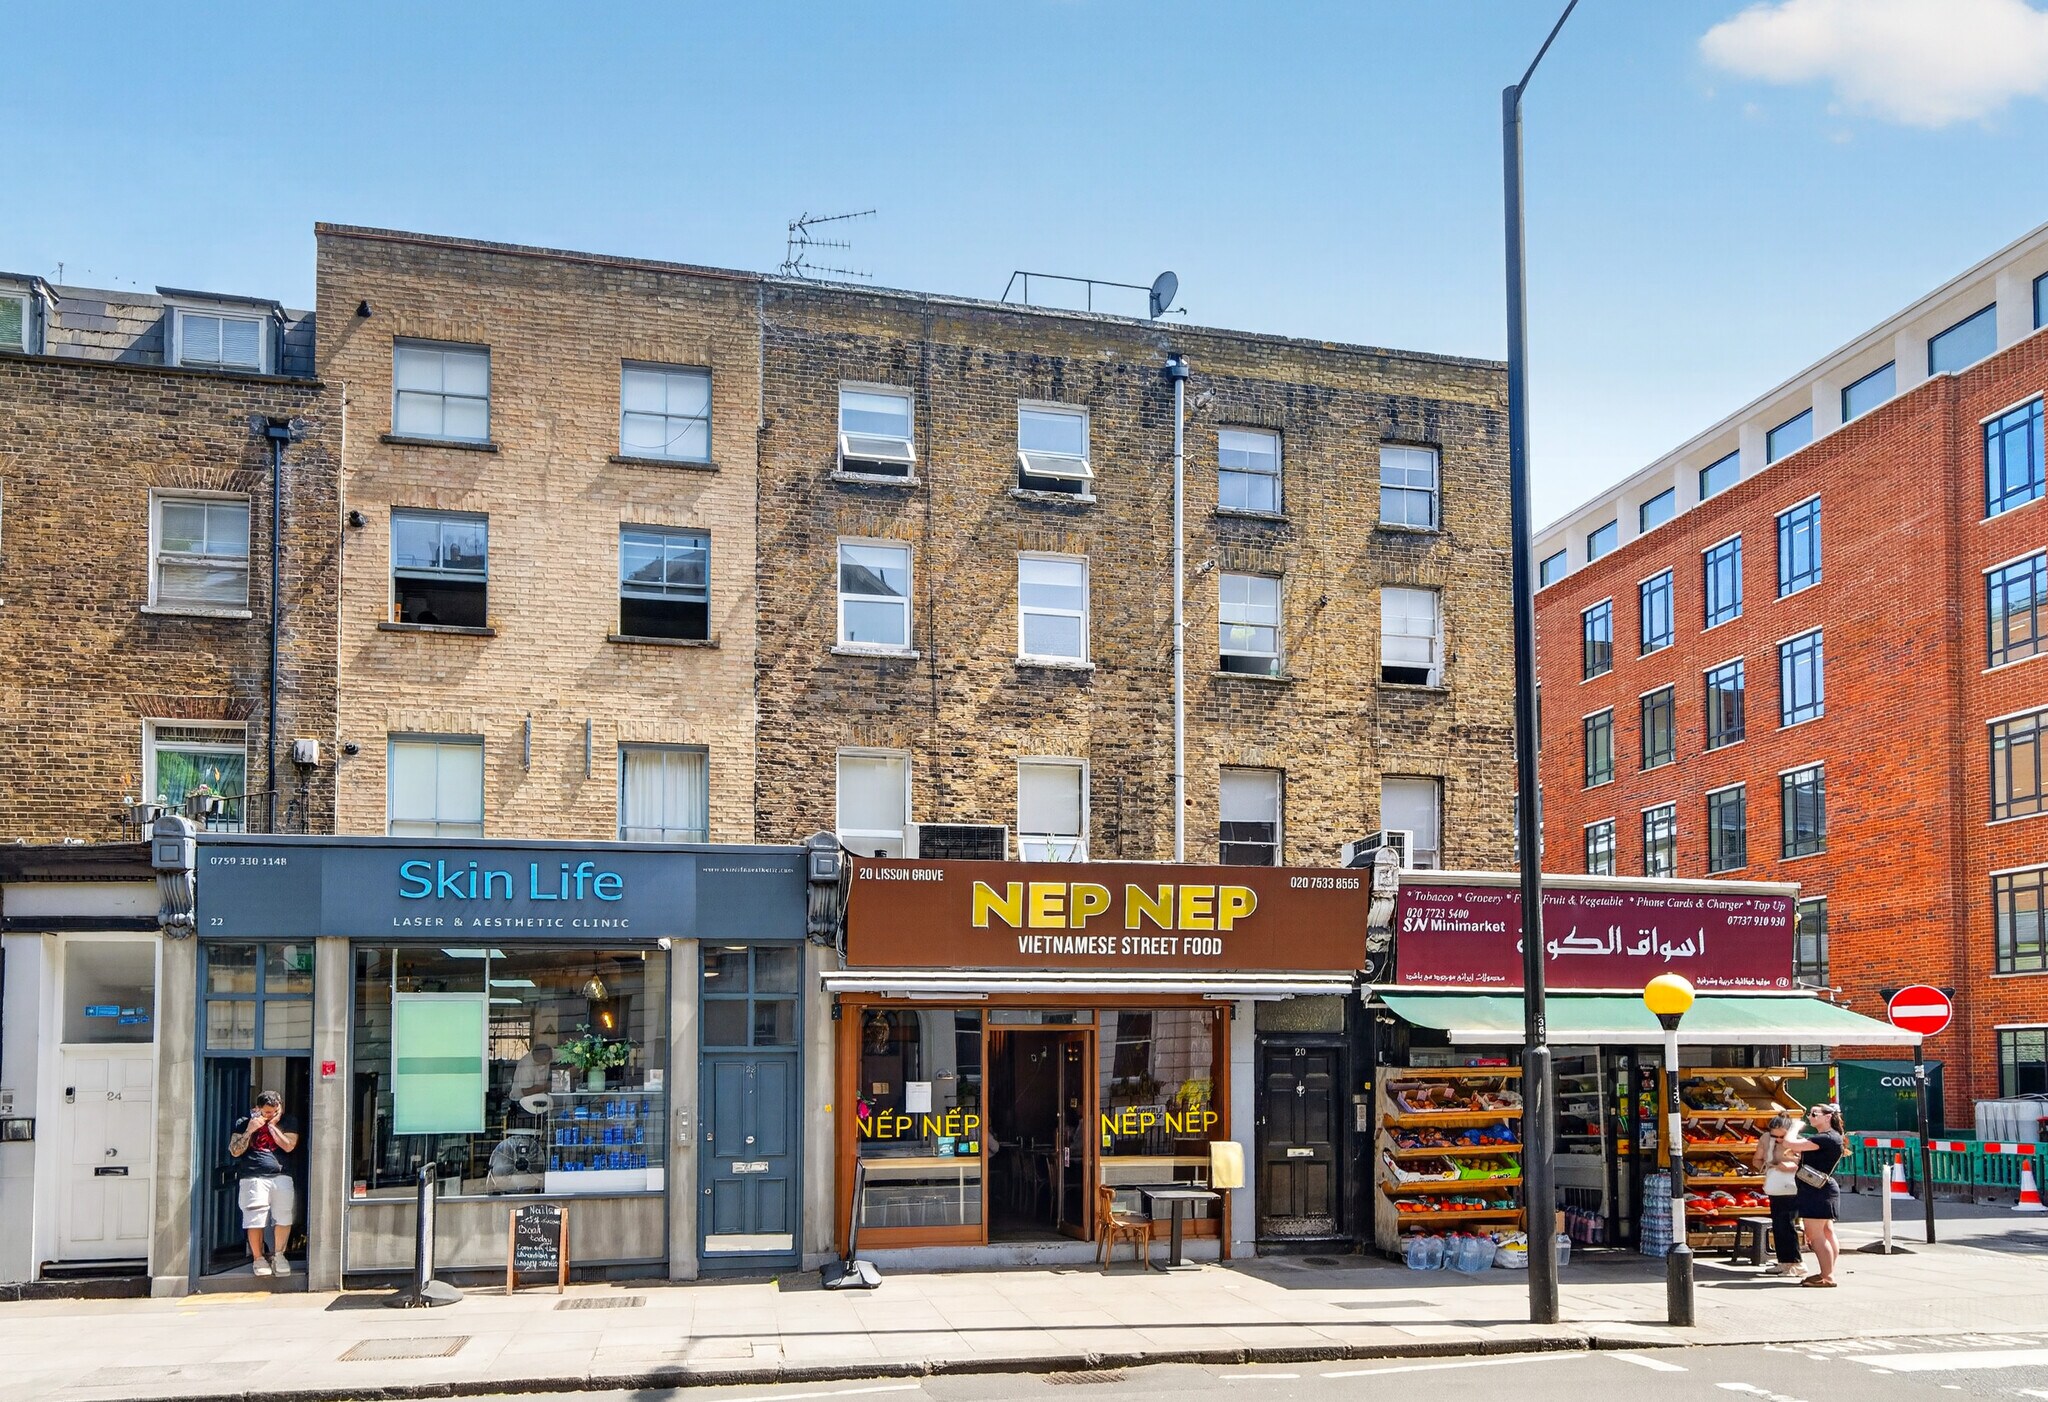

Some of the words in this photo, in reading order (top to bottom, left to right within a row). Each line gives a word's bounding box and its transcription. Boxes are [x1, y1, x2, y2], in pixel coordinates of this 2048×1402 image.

[210, 857, 236, 865] 0759
[239, 857, 259, 866] 330
[262, 857, 287, 866] 1148
[399, 859, 513, 900] Skin
[530, 861, 624, 901] Life
[859, 868, 873, 880] 20
[875, 868, 909, 880] LISSON
[912, 869, 944, 881] GROVE
[1290, 876, 1309, 888] 020
[1311, 877, 1334, 889] 7533
[1415, 891, 1454, 902] Tobacco
[1465, 892, 1503, 905] Grocery
[1542, 895, 1565, 905] Fruit
[1568, 895, 1577, 905] &
[1580, 896, 1623, 909] Vegetable
[1637, 897, 1664, 907] Phone
[1667, 897, 1693, 908] Cards
[1696, 899, 1705, 908] &
[1707, 898, 1743, 911] Charger
[972, 881, 1111, 929] NEP
[1125, 884, 1258, 931] NEP
[1753, 900, 1770, 911] Top
[1773, 901, 1786, 912] Up
[1406, 908, 1423, 918] 020
[1425, 908, 1445, 918] 7723
[1448, 909, 1469, 919] 5400
[210, 917, 224, 926] 22
[393, 917, 444, 927] LASER
[453, 917, 464, 927] &
[472, 917, 564, 928] AESTHETIC
[572, 918, 630, 928] CLINIC
[1430, 919, 1506, 933] Minimarket
[1727, 916, 1752, 926] 07737
[1754, 916, 1769, 926] 910
[1770, 917, 1786, 926] 930
[1018, 935, 1116, 955] VIETNAMESE
[1121, 936, 1179, 955] STREET
[1183, 937, 1222, 955] FOOD
[1294, 1047, 1306, 1056] 20
[106, 1091, 122, 1101] 24
